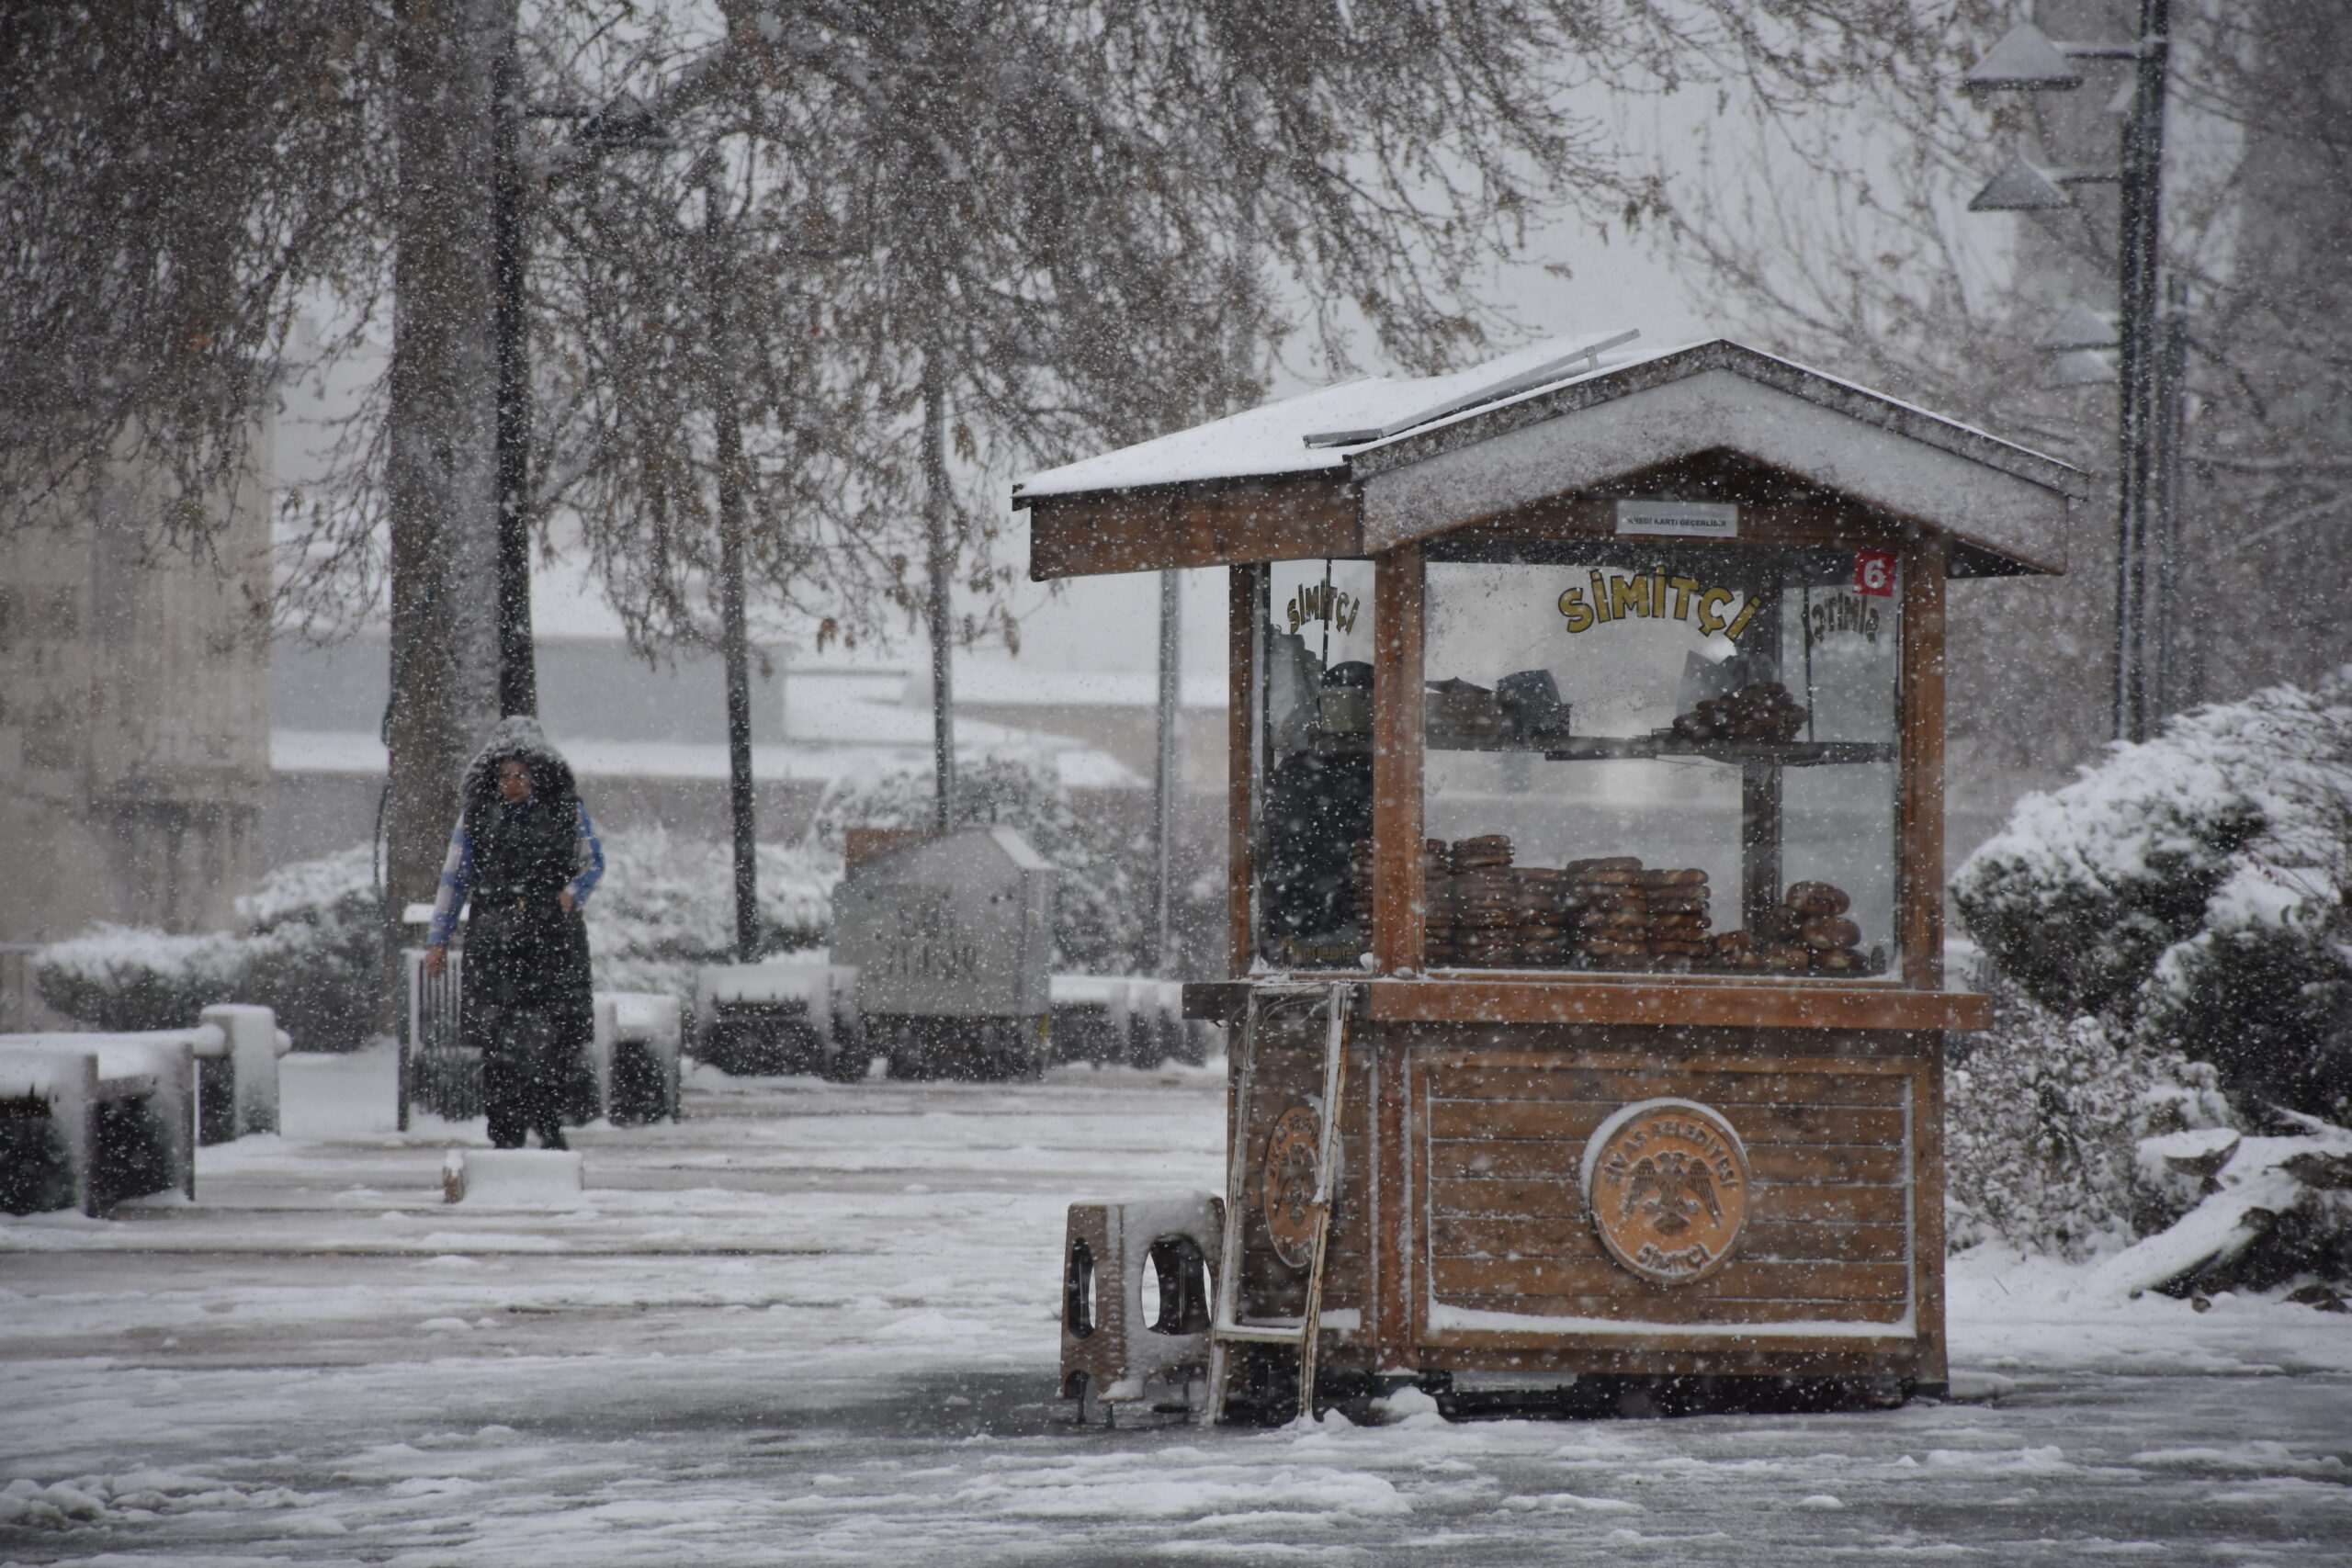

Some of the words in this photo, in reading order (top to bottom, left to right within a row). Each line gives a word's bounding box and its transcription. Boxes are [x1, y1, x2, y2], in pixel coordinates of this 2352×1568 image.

[1627, 516, 1653, 525] KREDİ
[1654, 518, 1679, 526] KARTI
[1863, 559, 1885, 589] 6
[1286, 578, 1360, 637] SİMİTÇİ
[1558, 565, 1762, 642] SİMİTÇİ
